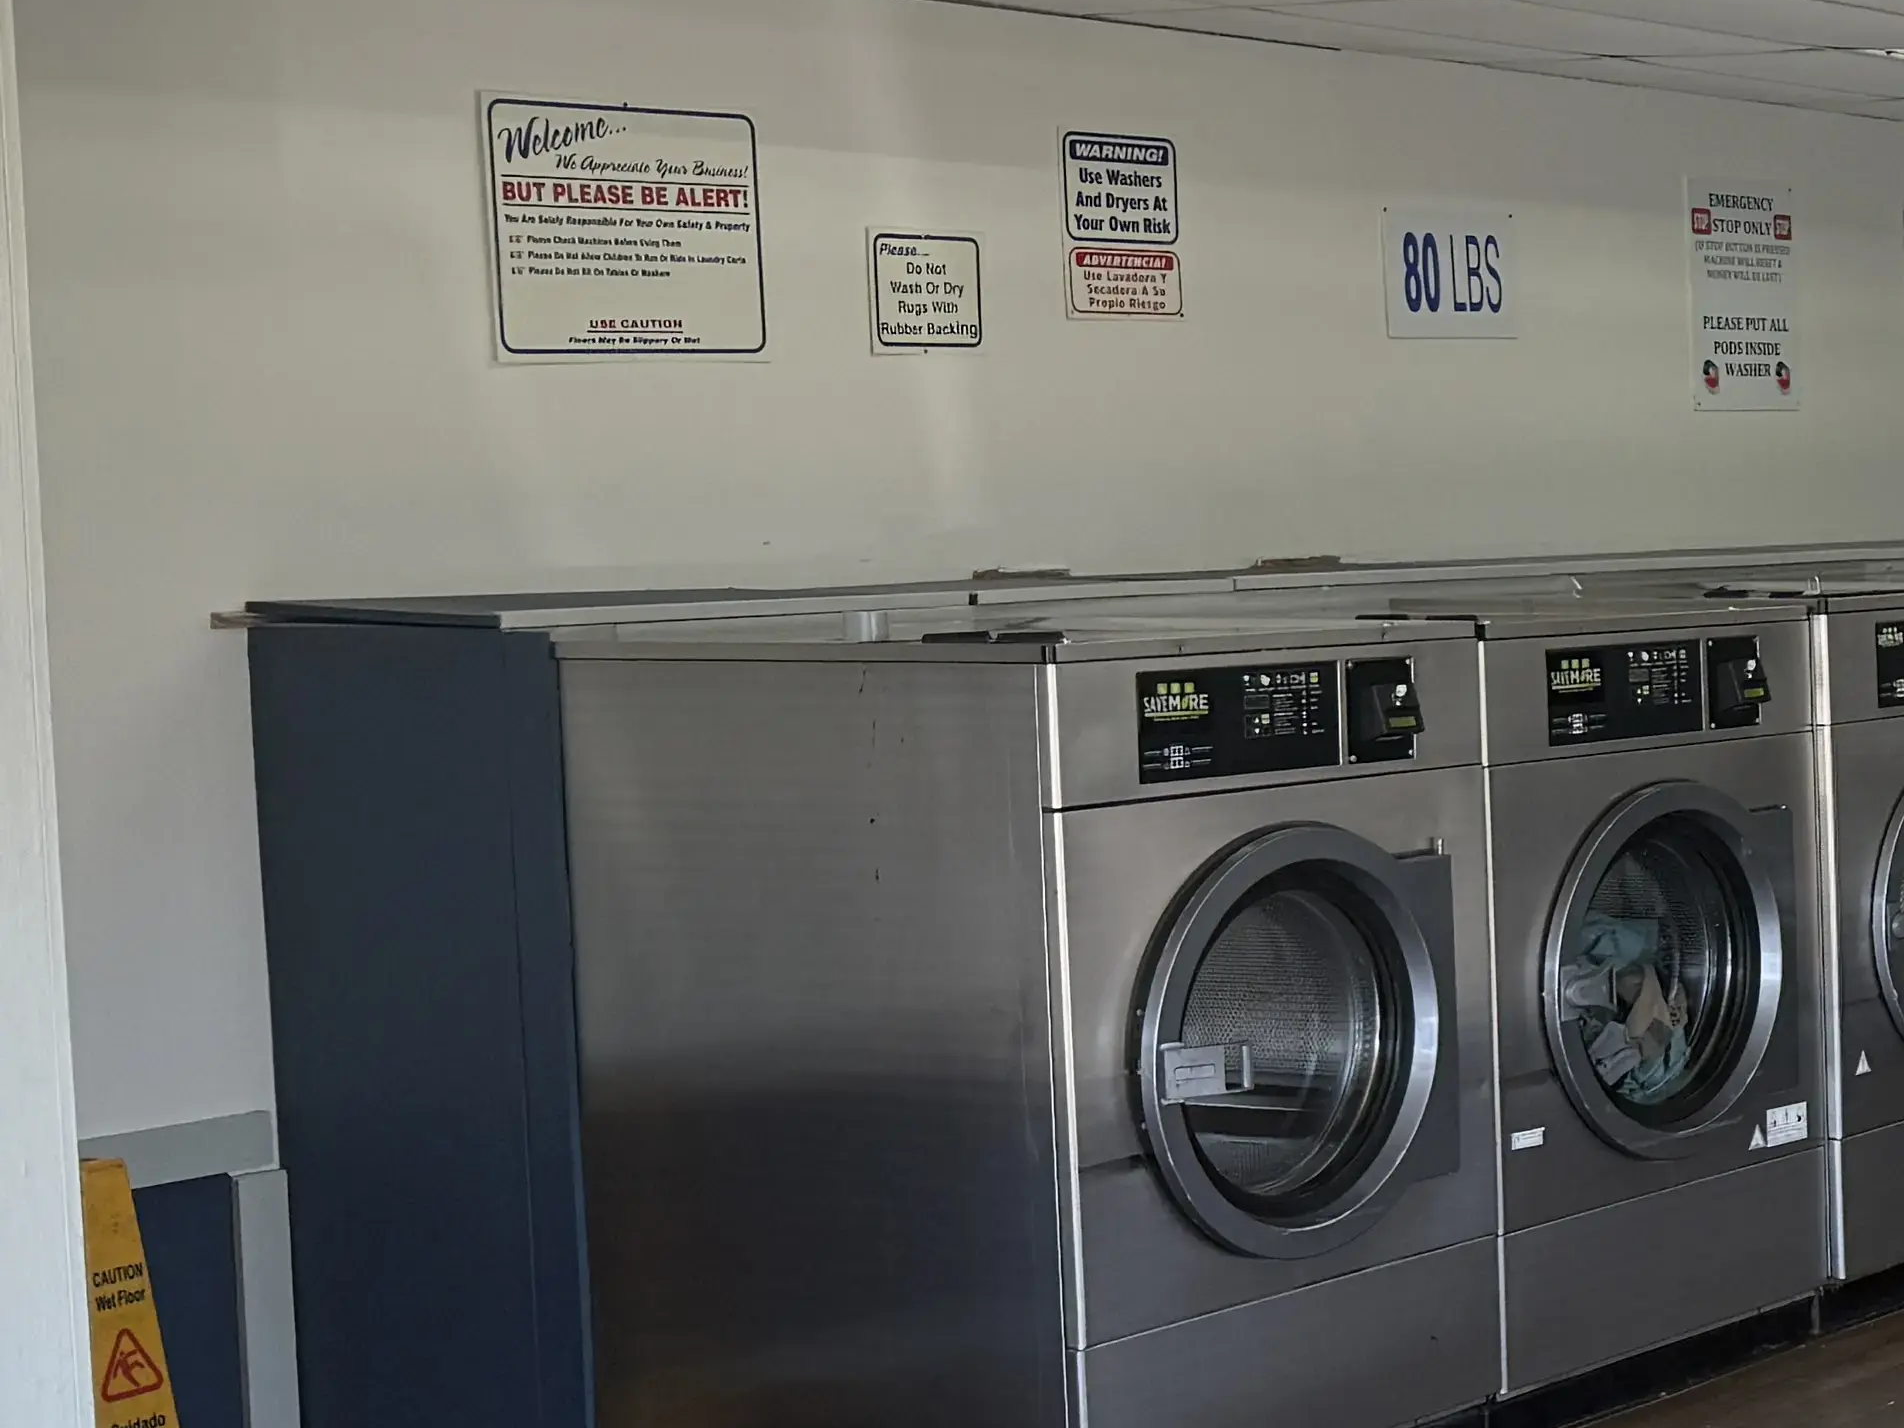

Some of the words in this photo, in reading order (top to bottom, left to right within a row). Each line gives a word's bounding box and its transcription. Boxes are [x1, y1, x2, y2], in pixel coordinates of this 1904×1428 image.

[1075, 142, 1164, 162] WARNING!
[581, 155, 650, 175] Appreciate
[656, 158, 688, 178] Your
[692, 160, 749, 179] Business!
[1079, 167, 1103, 184] Use
[1106, 168, 1162, 188] Washers
[502, 181, 545, 202] BUT
[553, 182, 634, 205] PLEASE
[641, 185, 668, 206] BE
[675, 186, 748, 208] ALERT!
[1075, 190, 1102, 208] And
[1105, 192, 1150, 213] Dryers
[1153, 195, 1168, 212] At
[1708, 193, 1774, 212] EMERGENCY
[521, 214, 536, 224] Are
[566, 216, 617, 227] Responsible
[619, 217, 633, 227] For
[656, 219, 675, 228] Own
[705, 221, 712, 230] &
[715, 221, 750, 232] Property
[1074, 214, 1105, 231] Your
[1109, 215, 1140, 233] Own
[1143, 217, 1171, 234] Risk
[1712, 218, 1741, 234] STOP
[1743, 220, 1772, 236] ONLY
[906, 262, 922, 275] Do
[926, 262, 947, 275] Not
[1083, 254, 1167, 268] ADVERTENCIA!
[1160, 273, 1167, 284] Y
[1403, 232, 1440, 312] 80
[1449, 234, 1502, 313] LBS
[890, 281, 922, 294] Wash
[926, 281, 939, 294] Or
[943, 282, 964, 298] Dry
[1141, 286, 1149, 296] A
[898, 300, 928, 316] Rugs
[932, 301, 958, 314] With
[1089, 297, 1125, 310] Propio
[1129, 298, 1166, 311] Riesgo
[589, 319, 617, 329] USE
[620, 319, 683, 329] CAUTION
[880, 322, 923, 335] Rubber
[926, 321, 978, 339] Backing
[1703, 316, 1744, 330] PLEASE
[1745, 317, 1768, 331] PUT
[1769, 318, 1789, 332] ALL
[1713, 341, 1743, 355] PODS
[1745, 342, 1781, 356] INSIDE
[1725, 363, 1772, 377] WASHER
[92, 1263, 144, 1288] CAUTION
[95, 1293, 117, 1312] Wet
[117, 1288, 146, 1307] Floor
